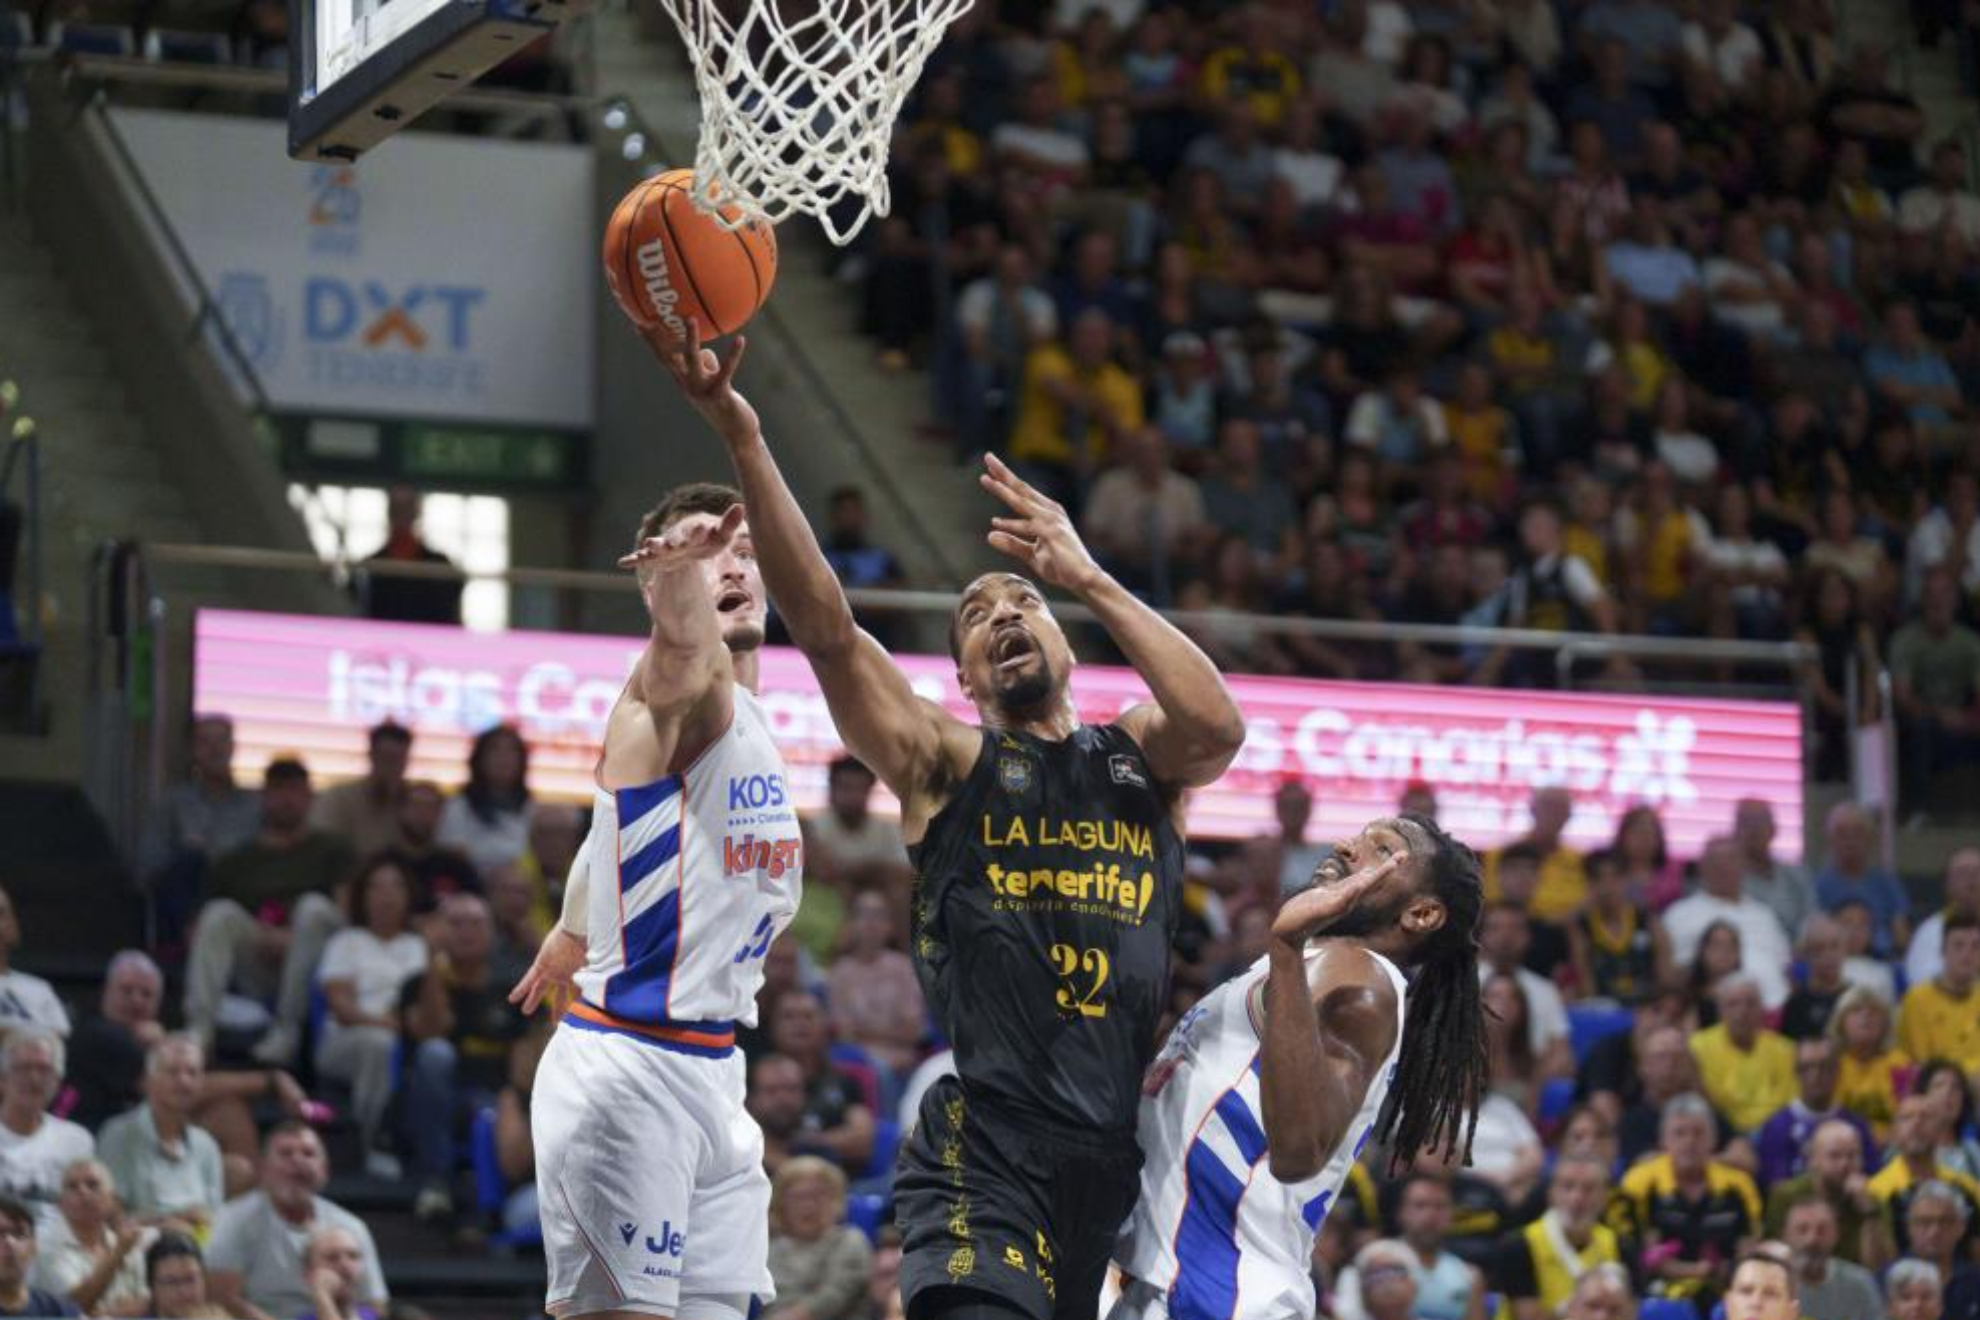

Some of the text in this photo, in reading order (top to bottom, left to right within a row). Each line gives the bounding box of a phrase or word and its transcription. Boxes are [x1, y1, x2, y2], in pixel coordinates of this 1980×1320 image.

[305, 277, 484, 351] DXT
[328, 650, 506, 732] Islas
[729, 773, 786, 811] KOS
[983, 814, 1154, 862] LA LAGUNA
[986, 861, 1154, 926] tenerife!
[645, 1220, 687, 1258] Je
